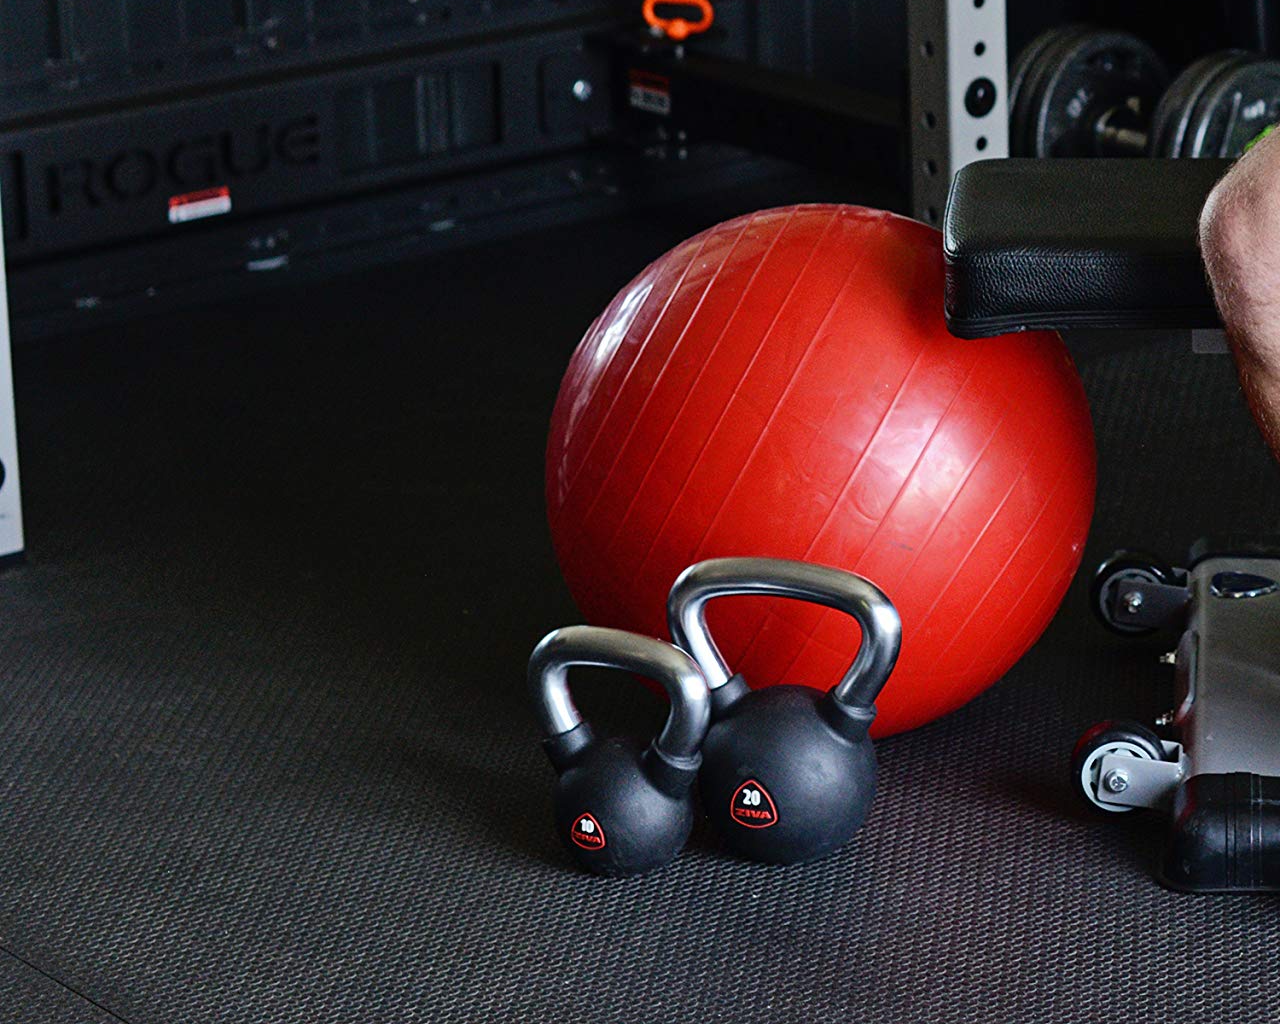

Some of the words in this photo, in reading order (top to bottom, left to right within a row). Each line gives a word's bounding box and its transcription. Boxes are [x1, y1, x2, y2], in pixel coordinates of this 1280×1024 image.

[742, 788, 761, 806] 20
[735, 807, 772, 819] ZIVA
[580, 818, 595, 834] 10
[574, 831, 601, 844] ZIVA
